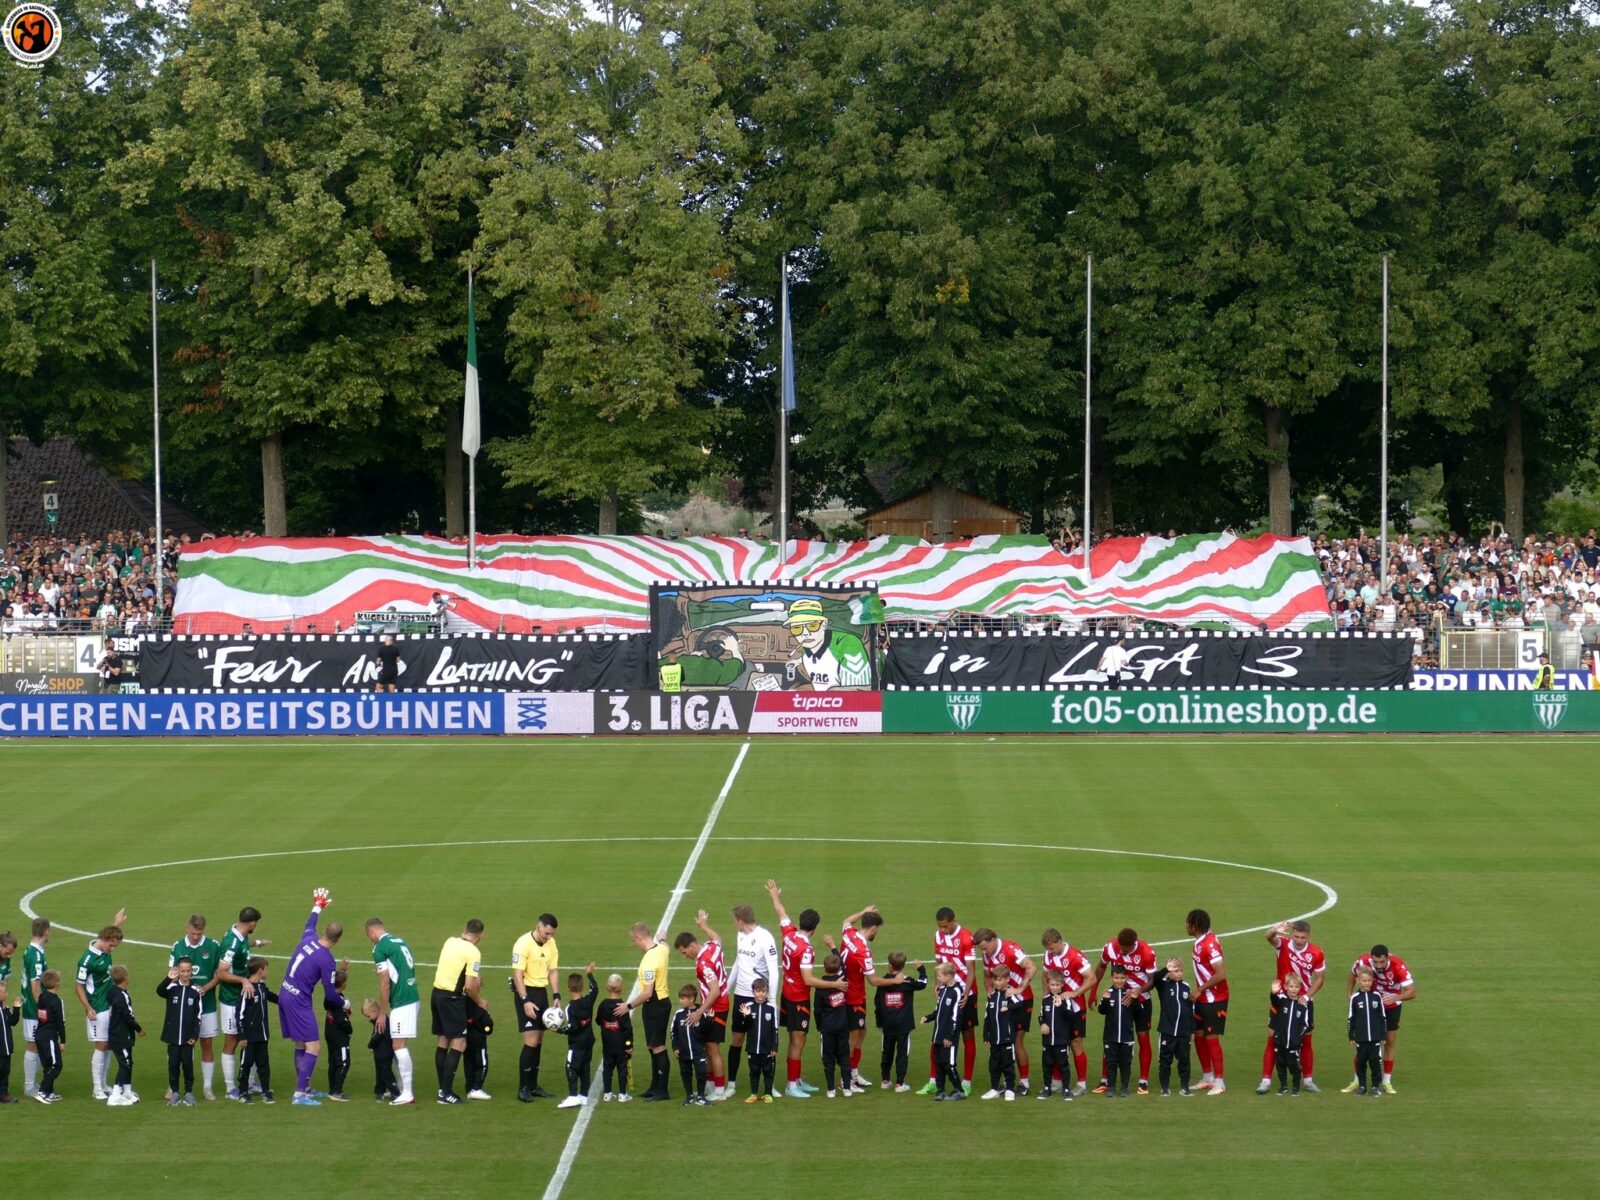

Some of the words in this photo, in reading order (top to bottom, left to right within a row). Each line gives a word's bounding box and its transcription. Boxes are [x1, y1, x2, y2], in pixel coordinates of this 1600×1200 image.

[46, 495, 54, 508] 4
[80, 644, 96, 668] 4
[1522, 638, 1538, 663] 5
[426, 646, 573, 686] LOATHING"
[924, 646, 990, 675] in
[1241, 646, 1303, 678] 3
[48, 678, 84, 690] SHOP
[0, 694, 492, 731] CHEREN-ARBEITSBÜHNEN
[608, 695, 642, 730] 3.
[650, 695, 740, 730] LIGA
[792, 694, 844, 710] tipico
[1051, 694, 1376, 730] fc05-onlineshop.de
[778, 717, 858, 727] SPORTWETTEN
[289, 952, 304, 978] 1
[400, 945, 414, 969] 8
